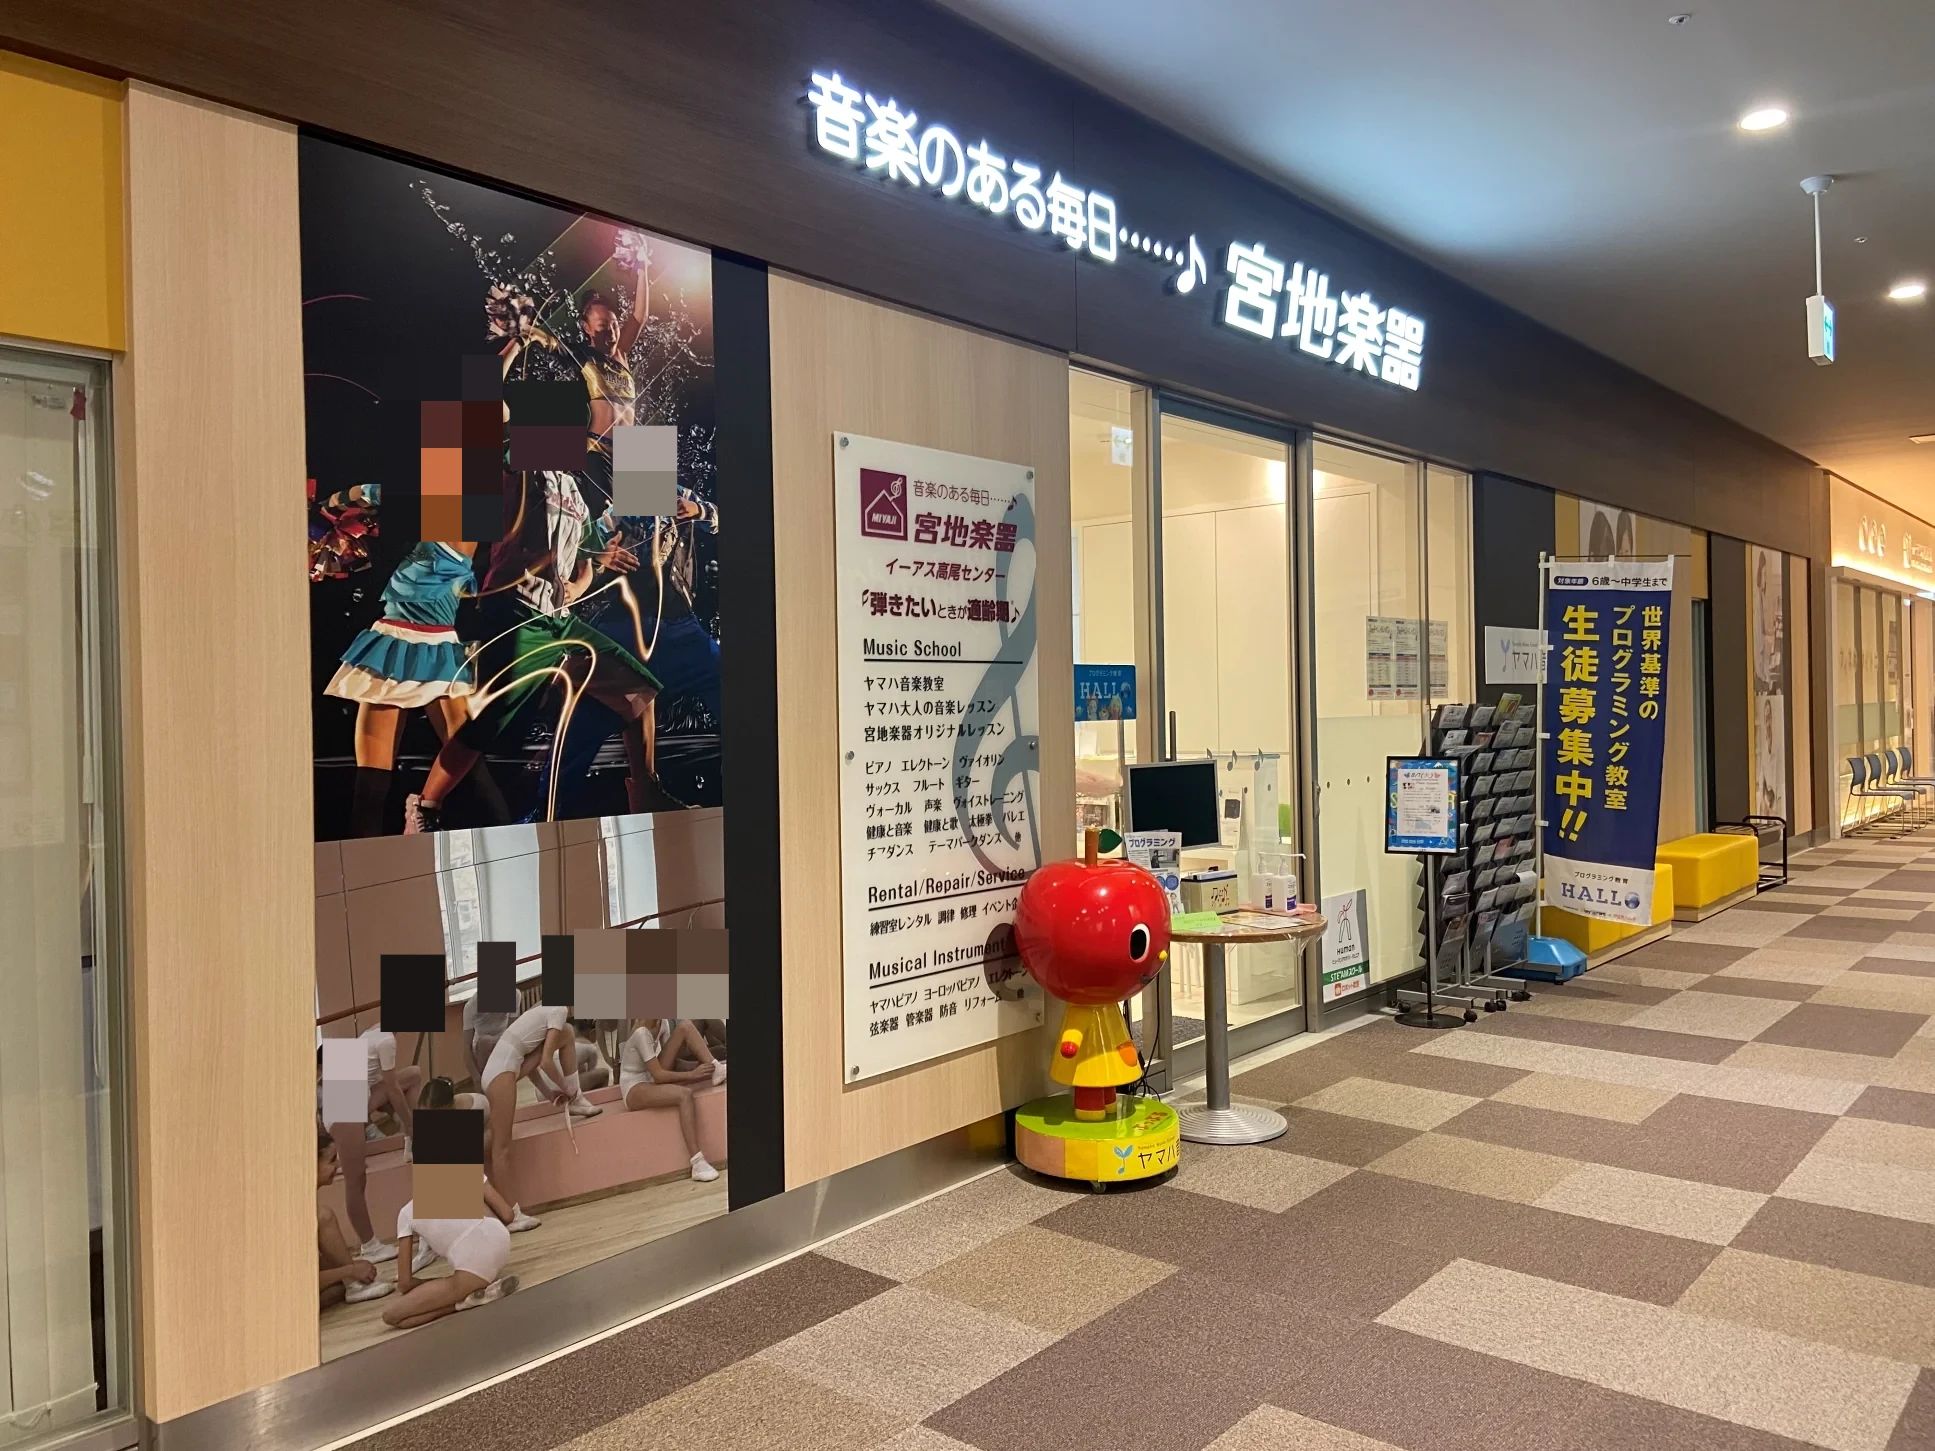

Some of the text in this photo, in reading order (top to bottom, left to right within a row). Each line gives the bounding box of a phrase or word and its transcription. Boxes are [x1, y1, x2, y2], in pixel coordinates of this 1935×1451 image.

[1224, 242, 1427, 392] 宮地楽器
[871, 512, 898, 526] MIYAJI
[914, 512, 1018, 553] 宮地楽器
[886, 558, 1006, 583] イーアス高尾センター
[863, 638, 962, 658] Music School
[1638, 605, 1664, 721] 世界基準の
[864, 675, 945, 693] ヤマハ音楽教室
[864, 699, 996, 717] ヤマハ大人の音楽レッスン
[1604, 604, 1636, 811] プログラミング教室
[864, 722, 1005, 743] 宮地楽器オリジナルレッスン
[865, 754, 1005, 775] ピアノ エレクトーン ヴァイオリン
[865, 775, 980, 797] サックス フルート ギター
[866, 790, 1025, 819] ヴォーカル 声楽 ヴォイストレーニング
[866, 809, 1026, 841] 健康と音楽 健康と歌 太極拳 バレエ
[928, 831, 1002, 854] テーマパークダンス
[1128, 837, 1176, 848] プログラミング
[868, 866, 1026, 904] Rental/Repair/Service
[869, 911, 933, 937] 練習室レンタル
[937, 908, 956, 925] 調律
[960, 903, 978, 921] 修理
[868, 951, 928, 980] Musical
[869, 990, 919, 1015] ヤマハピアノ
[924, 976, 981, 1002] ヨーロッパピアノ
[869, 1016, 900, 1039] 弦楽器
[905, 1007, 934, 1029] 管楽器
[939, 1001, 958, 1020] 防音
[964, 990, 1003, 1012] リフォーム
